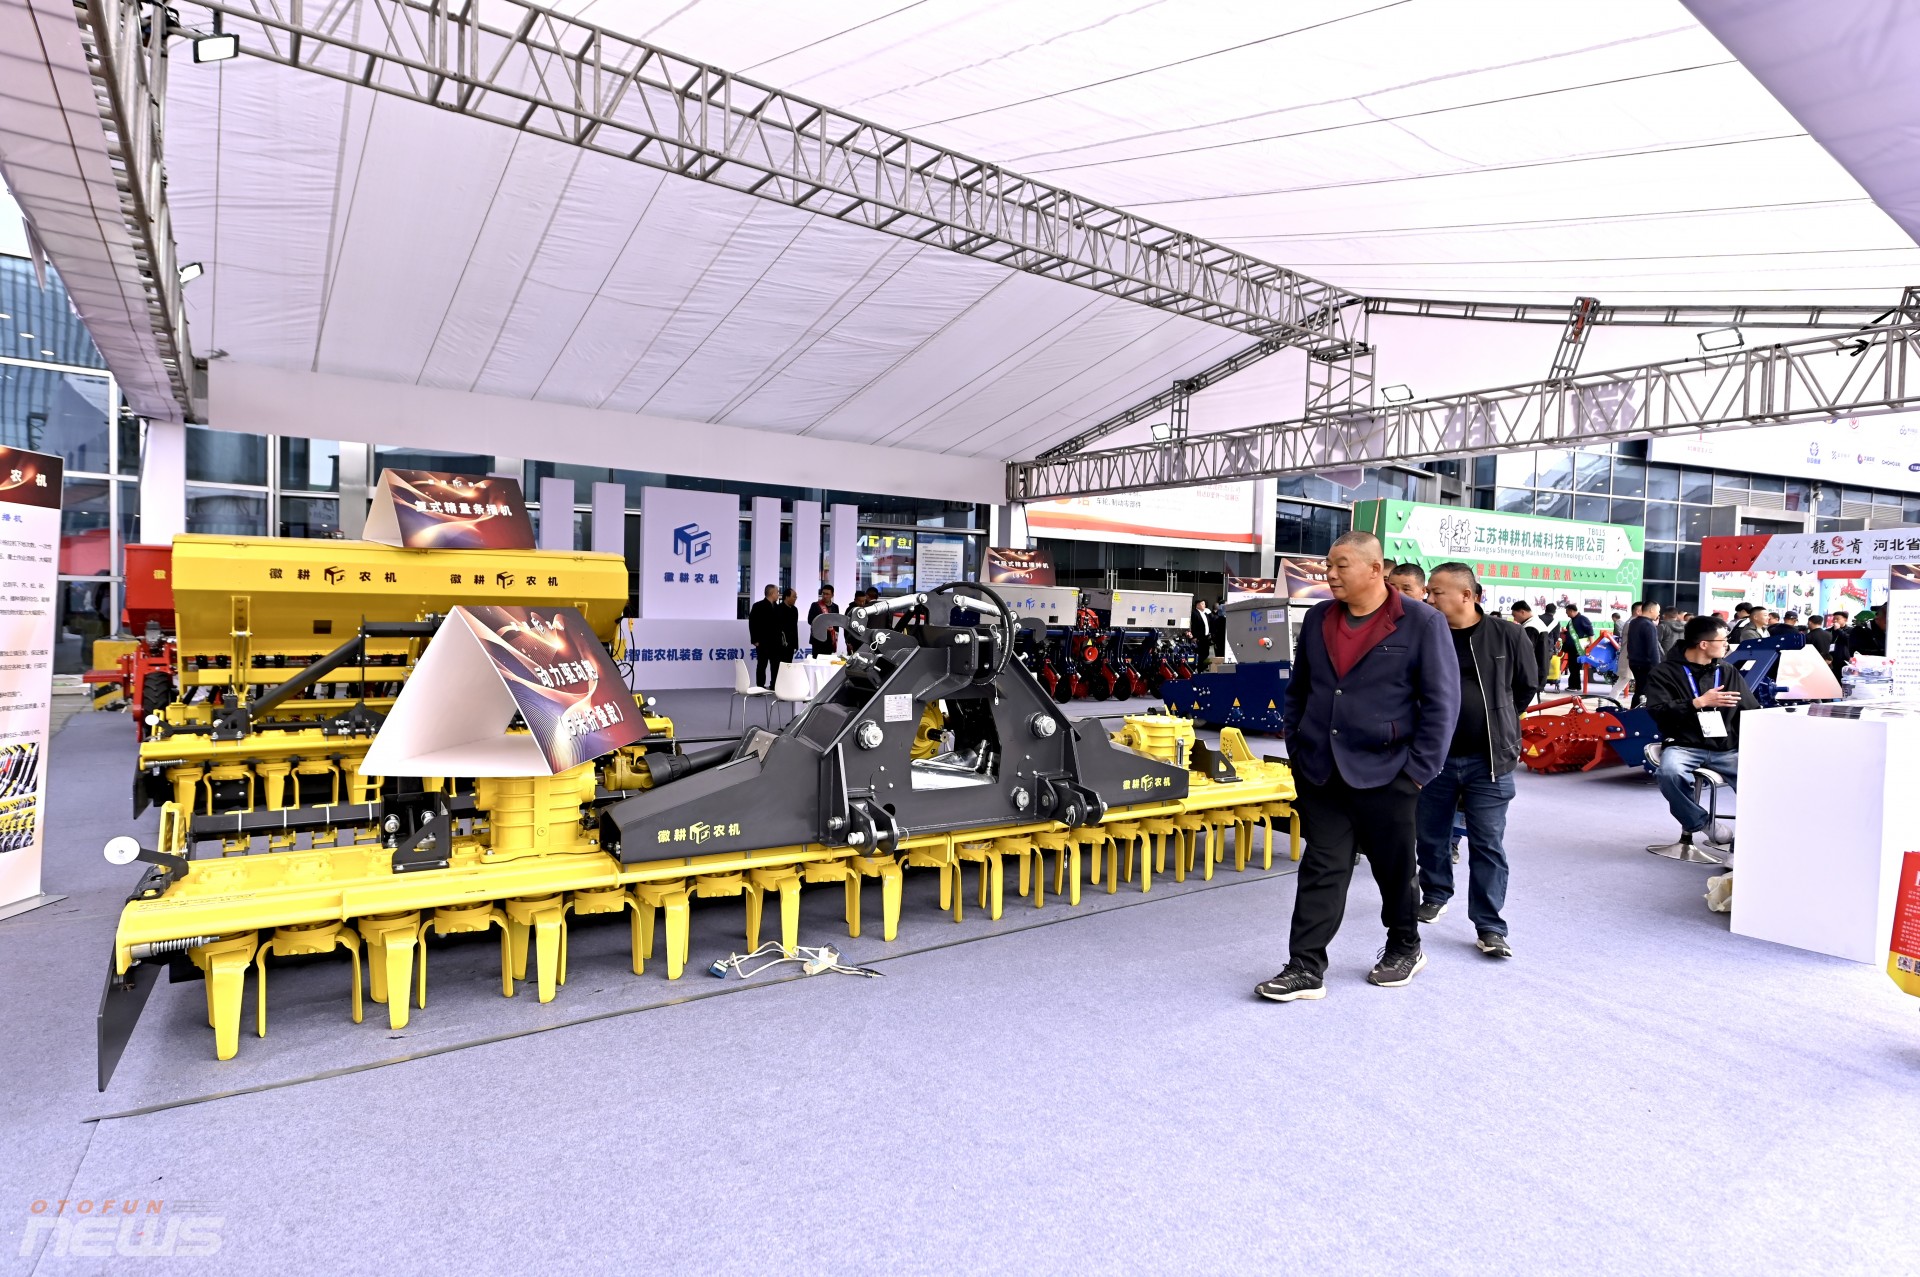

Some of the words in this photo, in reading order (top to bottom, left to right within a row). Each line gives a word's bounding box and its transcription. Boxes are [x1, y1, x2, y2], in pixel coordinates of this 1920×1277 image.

[1474, 526, 1605, 553] 江苏神耕机械科技有限公司
[1873, 538, 1920, 552] 河北省
[269, 568, 311, 580] 徽耕
[359, 571, 398, 583] 农机
[663, 572, 720, 584] 徽耕农机
[1476, 563, 1520, 578] 智造精品
[1531, 567, 1572, 581] 神耕农机
[450, 574, 485, 585] 徽耕
[526, 576, 559, 587] 农机
[534, 659, 599, 688] 动力驱动耙
[657, 828, 687, 843] 徽耕
[713, 823, 741, 838] 农机
